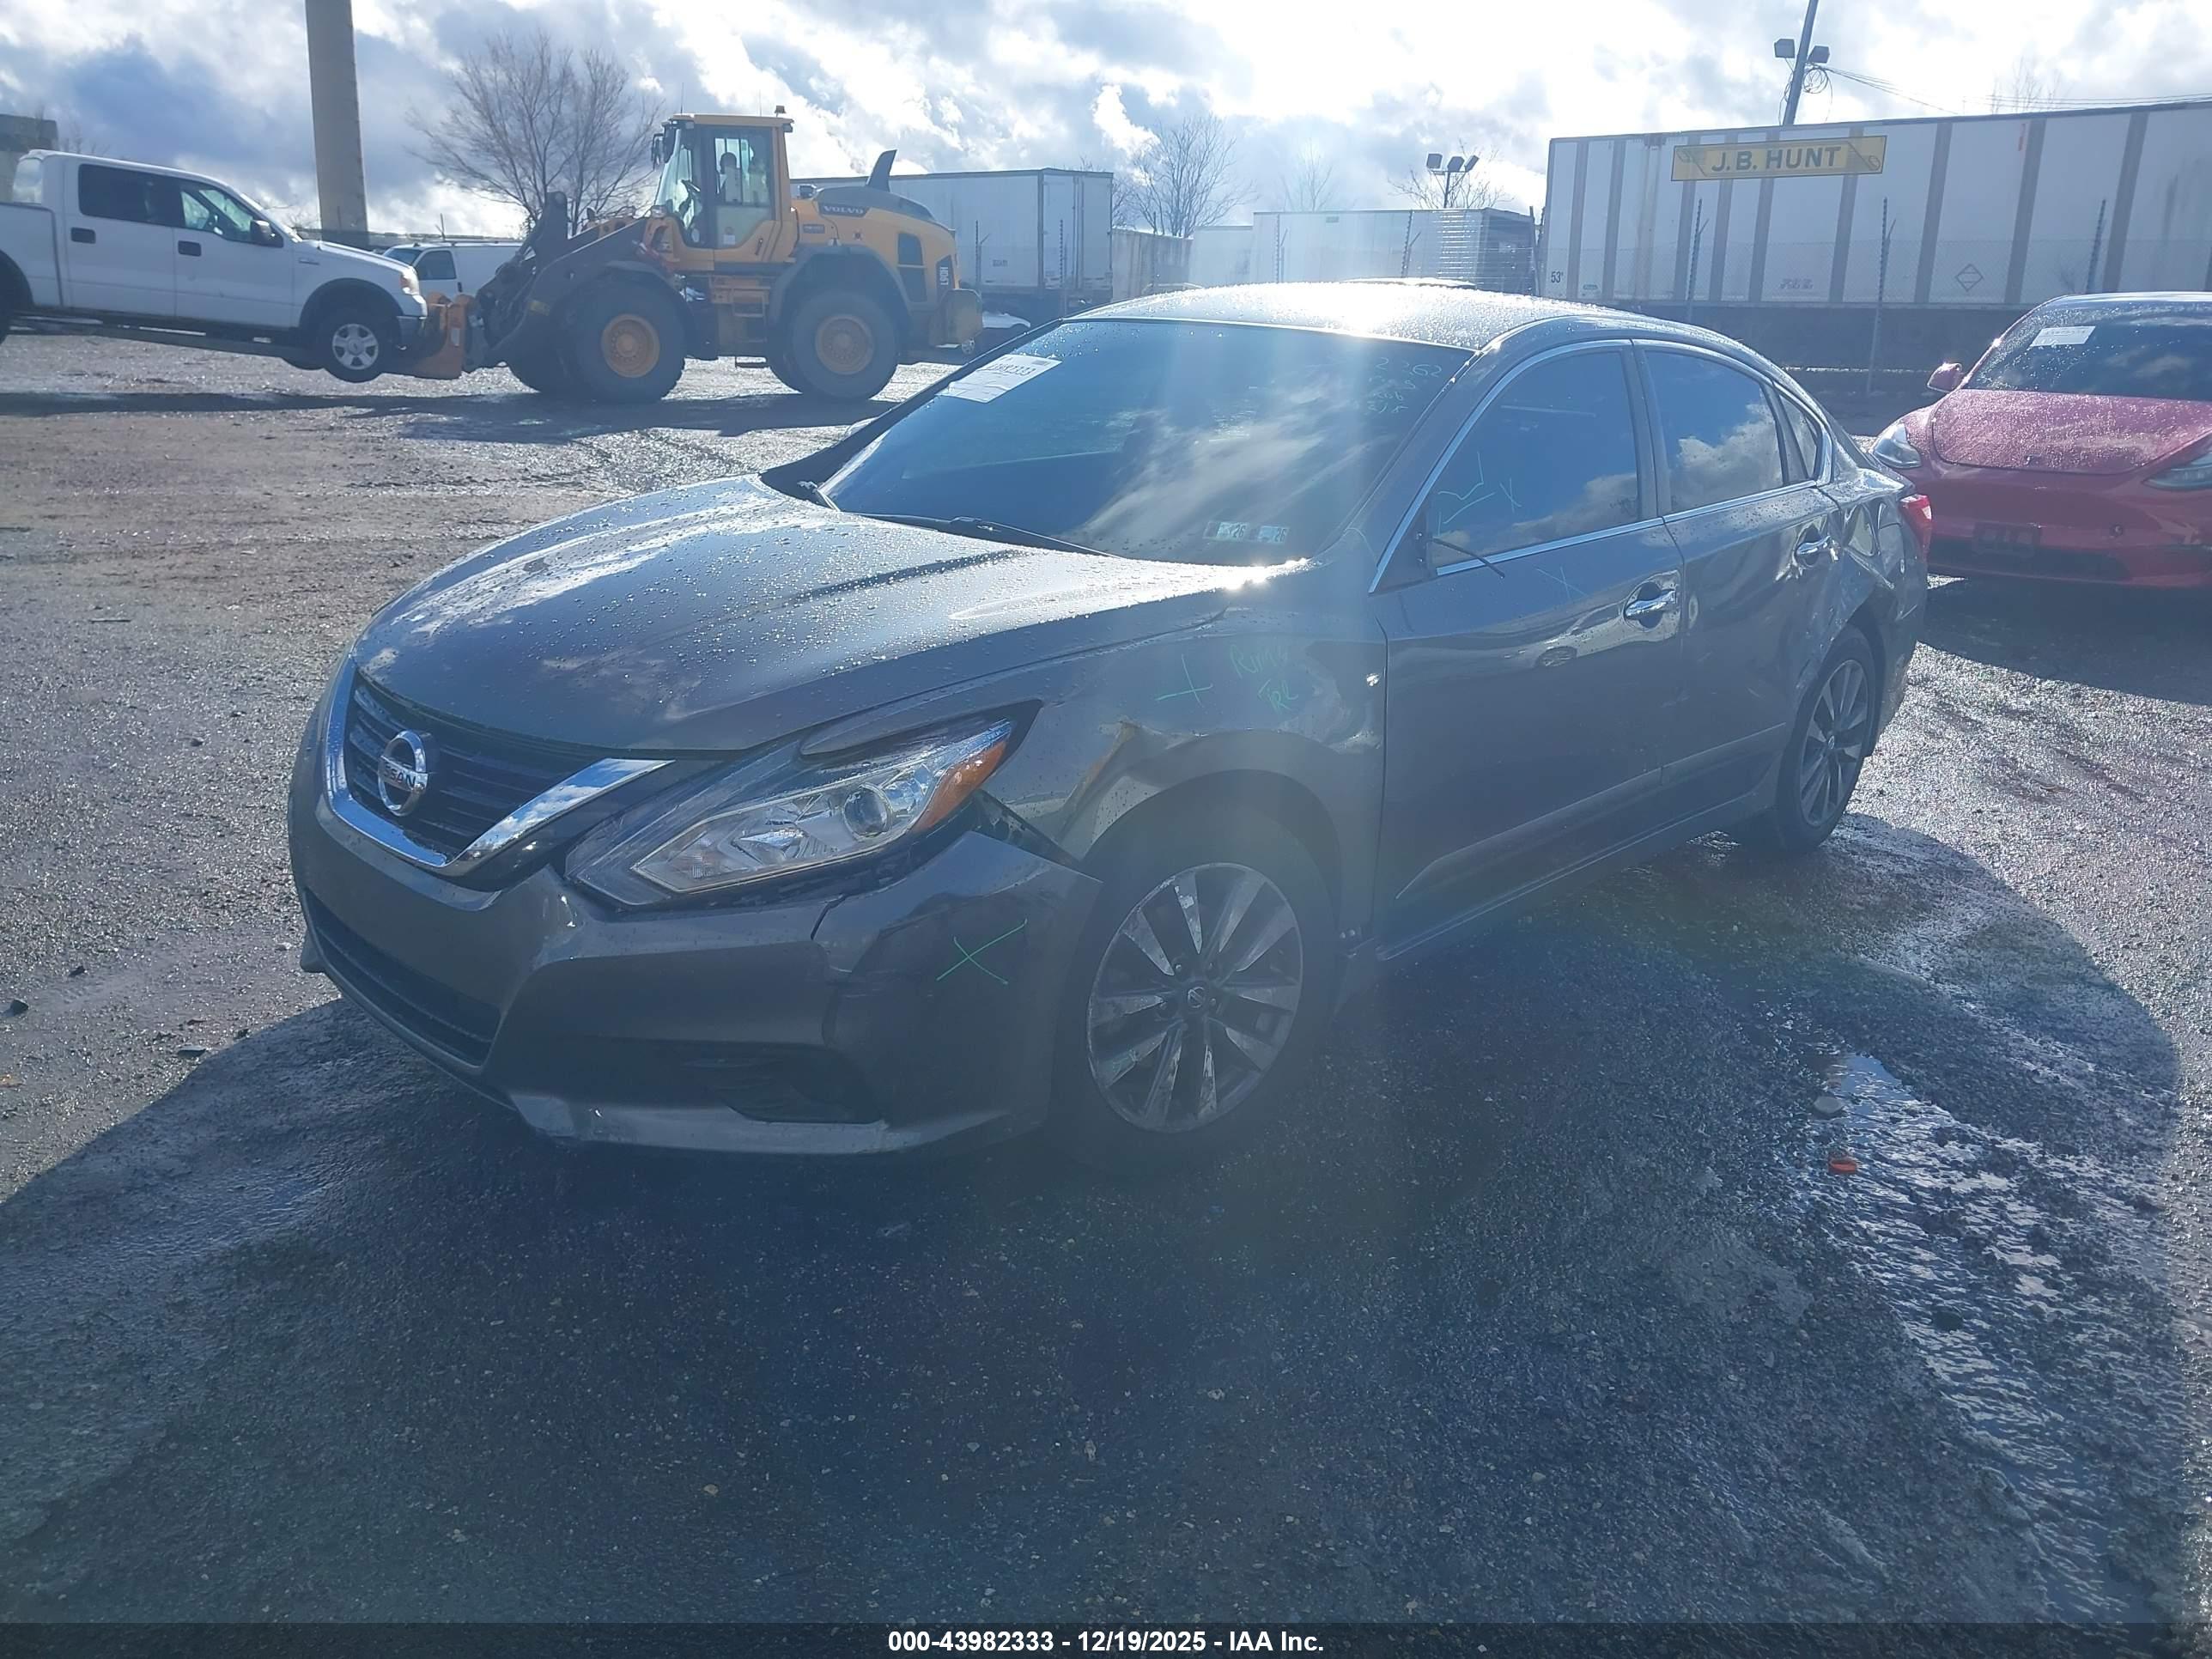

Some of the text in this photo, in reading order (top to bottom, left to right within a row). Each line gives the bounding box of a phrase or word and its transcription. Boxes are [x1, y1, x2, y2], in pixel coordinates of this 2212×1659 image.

[1711, 146, 1842, 172] J.B. HUNT
[823, 205, 864, 215] VOLVO
[939, 266, 949, 286] L90H
